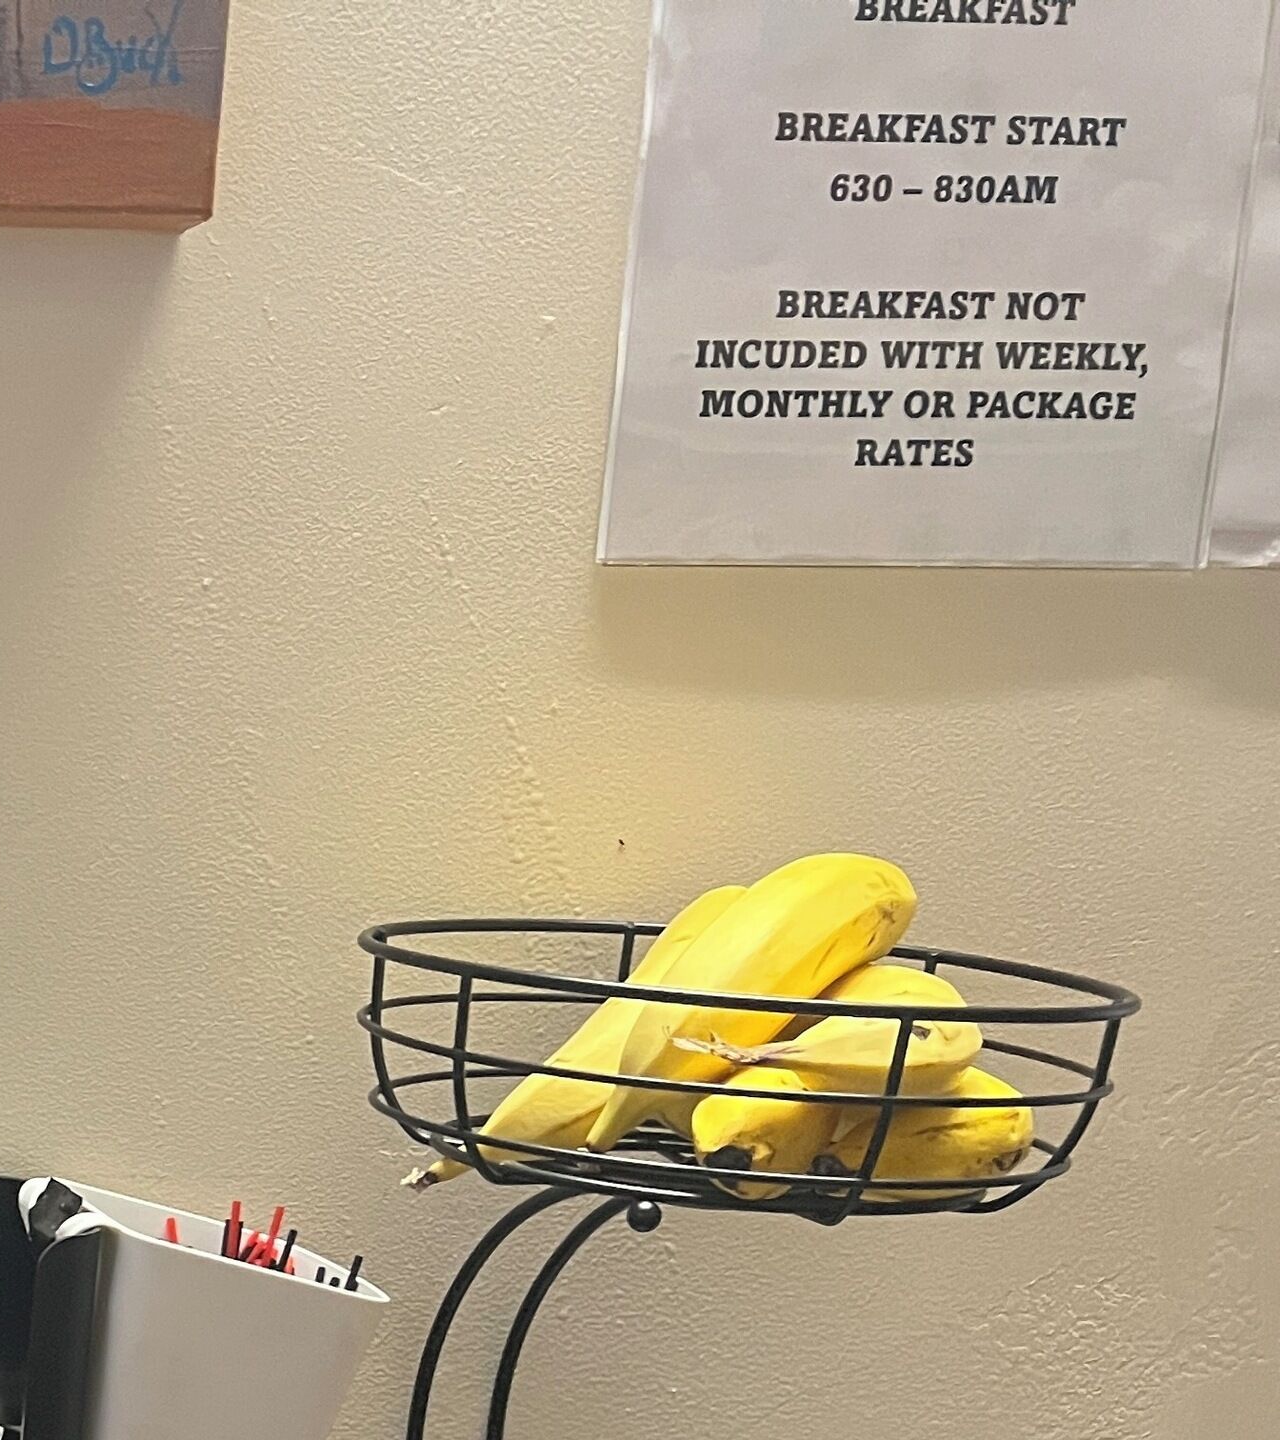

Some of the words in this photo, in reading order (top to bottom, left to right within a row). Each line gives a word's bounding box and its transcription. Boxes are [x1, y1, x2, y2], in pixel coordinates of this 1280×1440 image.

[854, 0, 1076, 26] BREAKFAST
[775, 112, 996, 145] BREAKFAST
[1006, 115, 1128, 147] START
[829, 174, 893, 202] 630
[933, 175, 1059, 204] 830AM
[776, 289, 994, 320] BREAKFAST
[1005, 292, 1086, 321] NOT
[694, 339, 868, 369] INCUDED
[881, 340, 984, 369] WITH
[996, 341, 1149, 378] WEEKLY,
[698, 390, 894, 418] MONTHLY
[903, 390, 956, 418] OR
[966, 391, 1137, 420] PACKAGE
[854, 438, 975, 467] RATES
